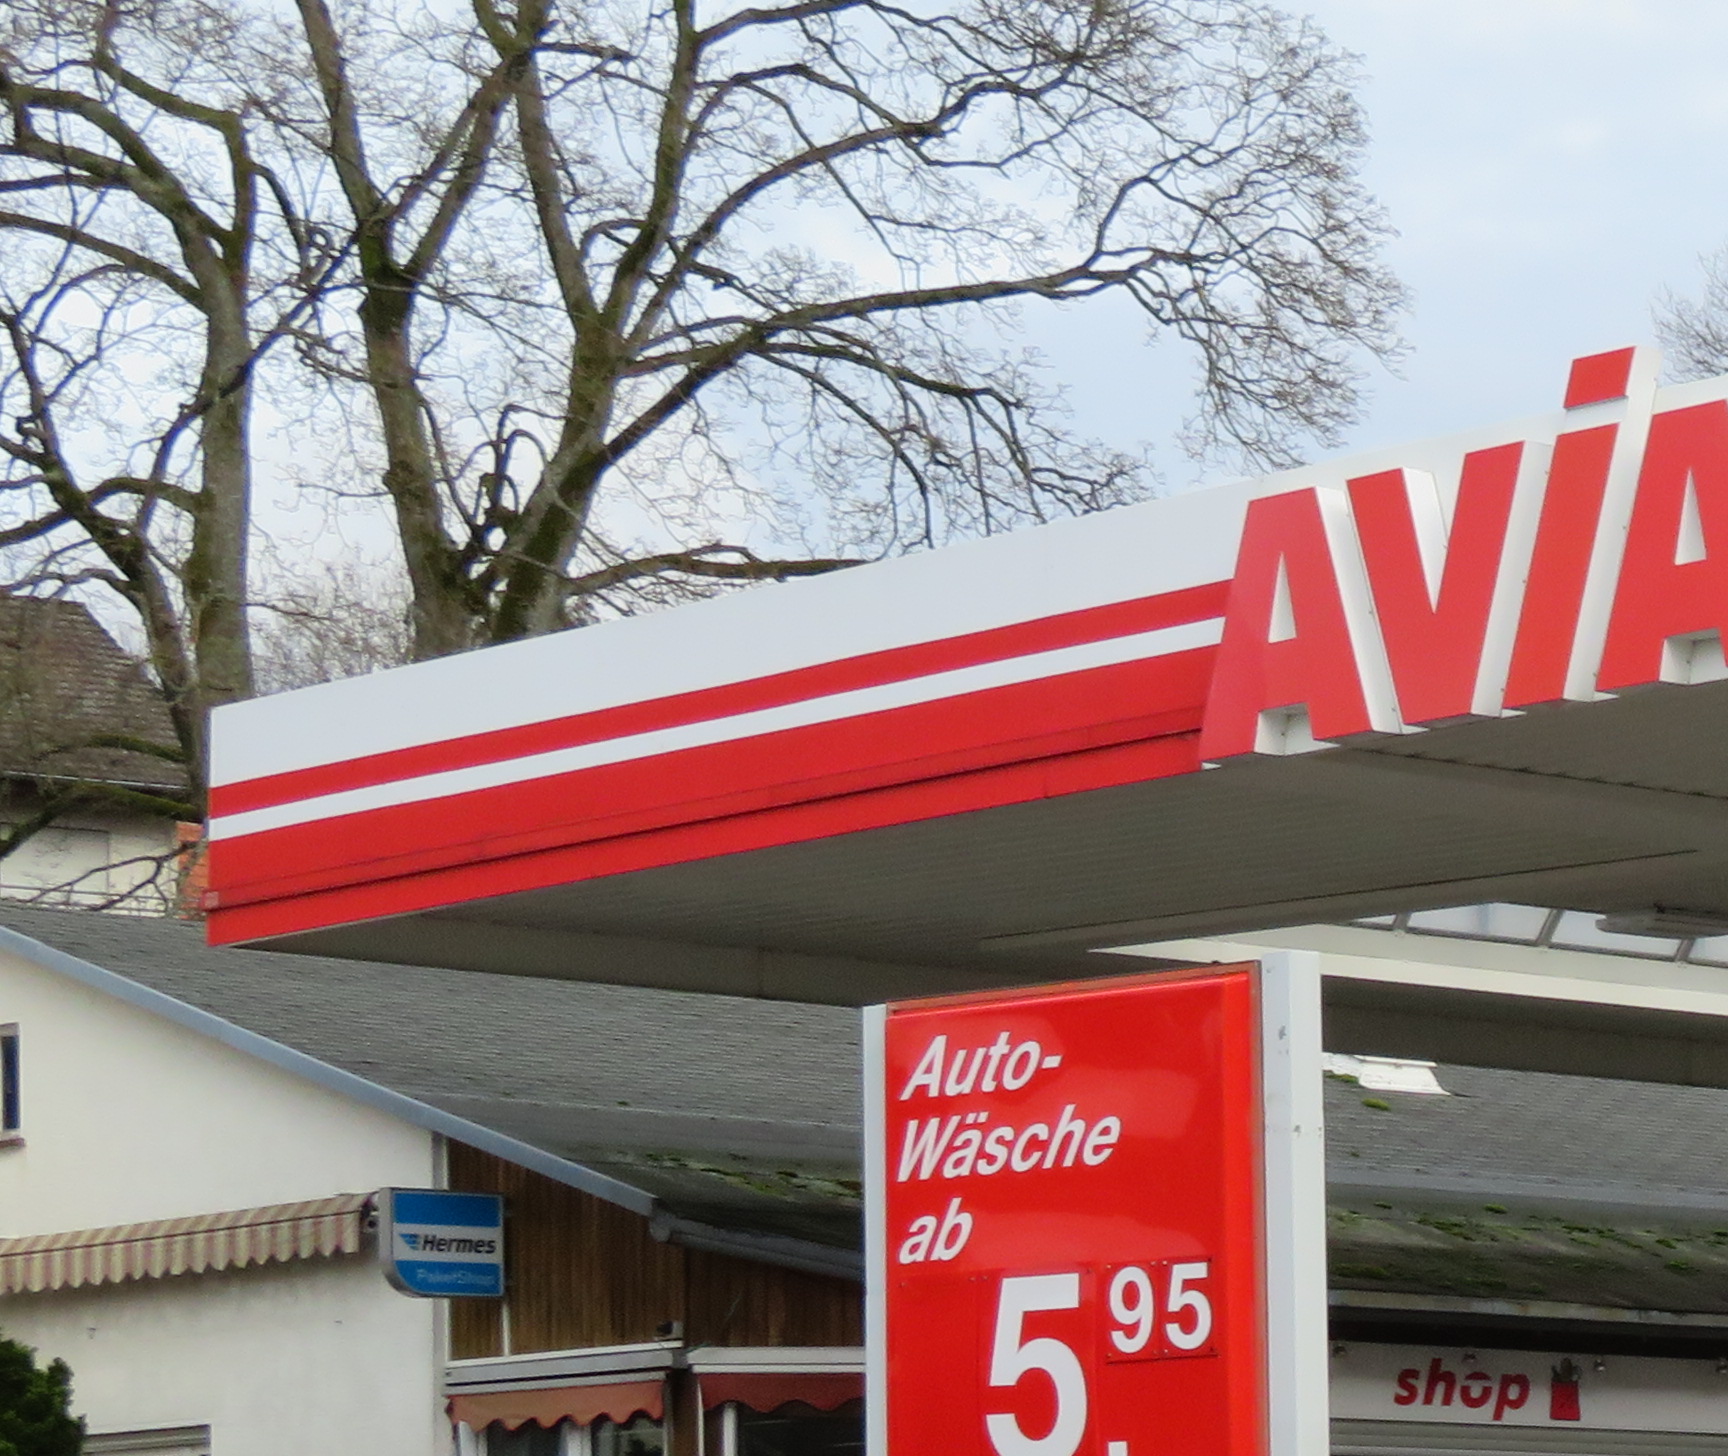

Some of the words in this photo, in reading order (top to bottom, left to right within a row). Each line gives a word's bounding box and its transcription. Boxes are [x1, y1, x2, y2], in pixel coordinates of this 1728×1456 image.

[899, 1030, 1062, 1103] Auto-
[896, 1103, 1121, 1183] Wäsche
[422, 1234, 497, 1254] Hermes
[897, 1197, 973, 1265] ab
[1394, 1357, 1531, 1421] shop
